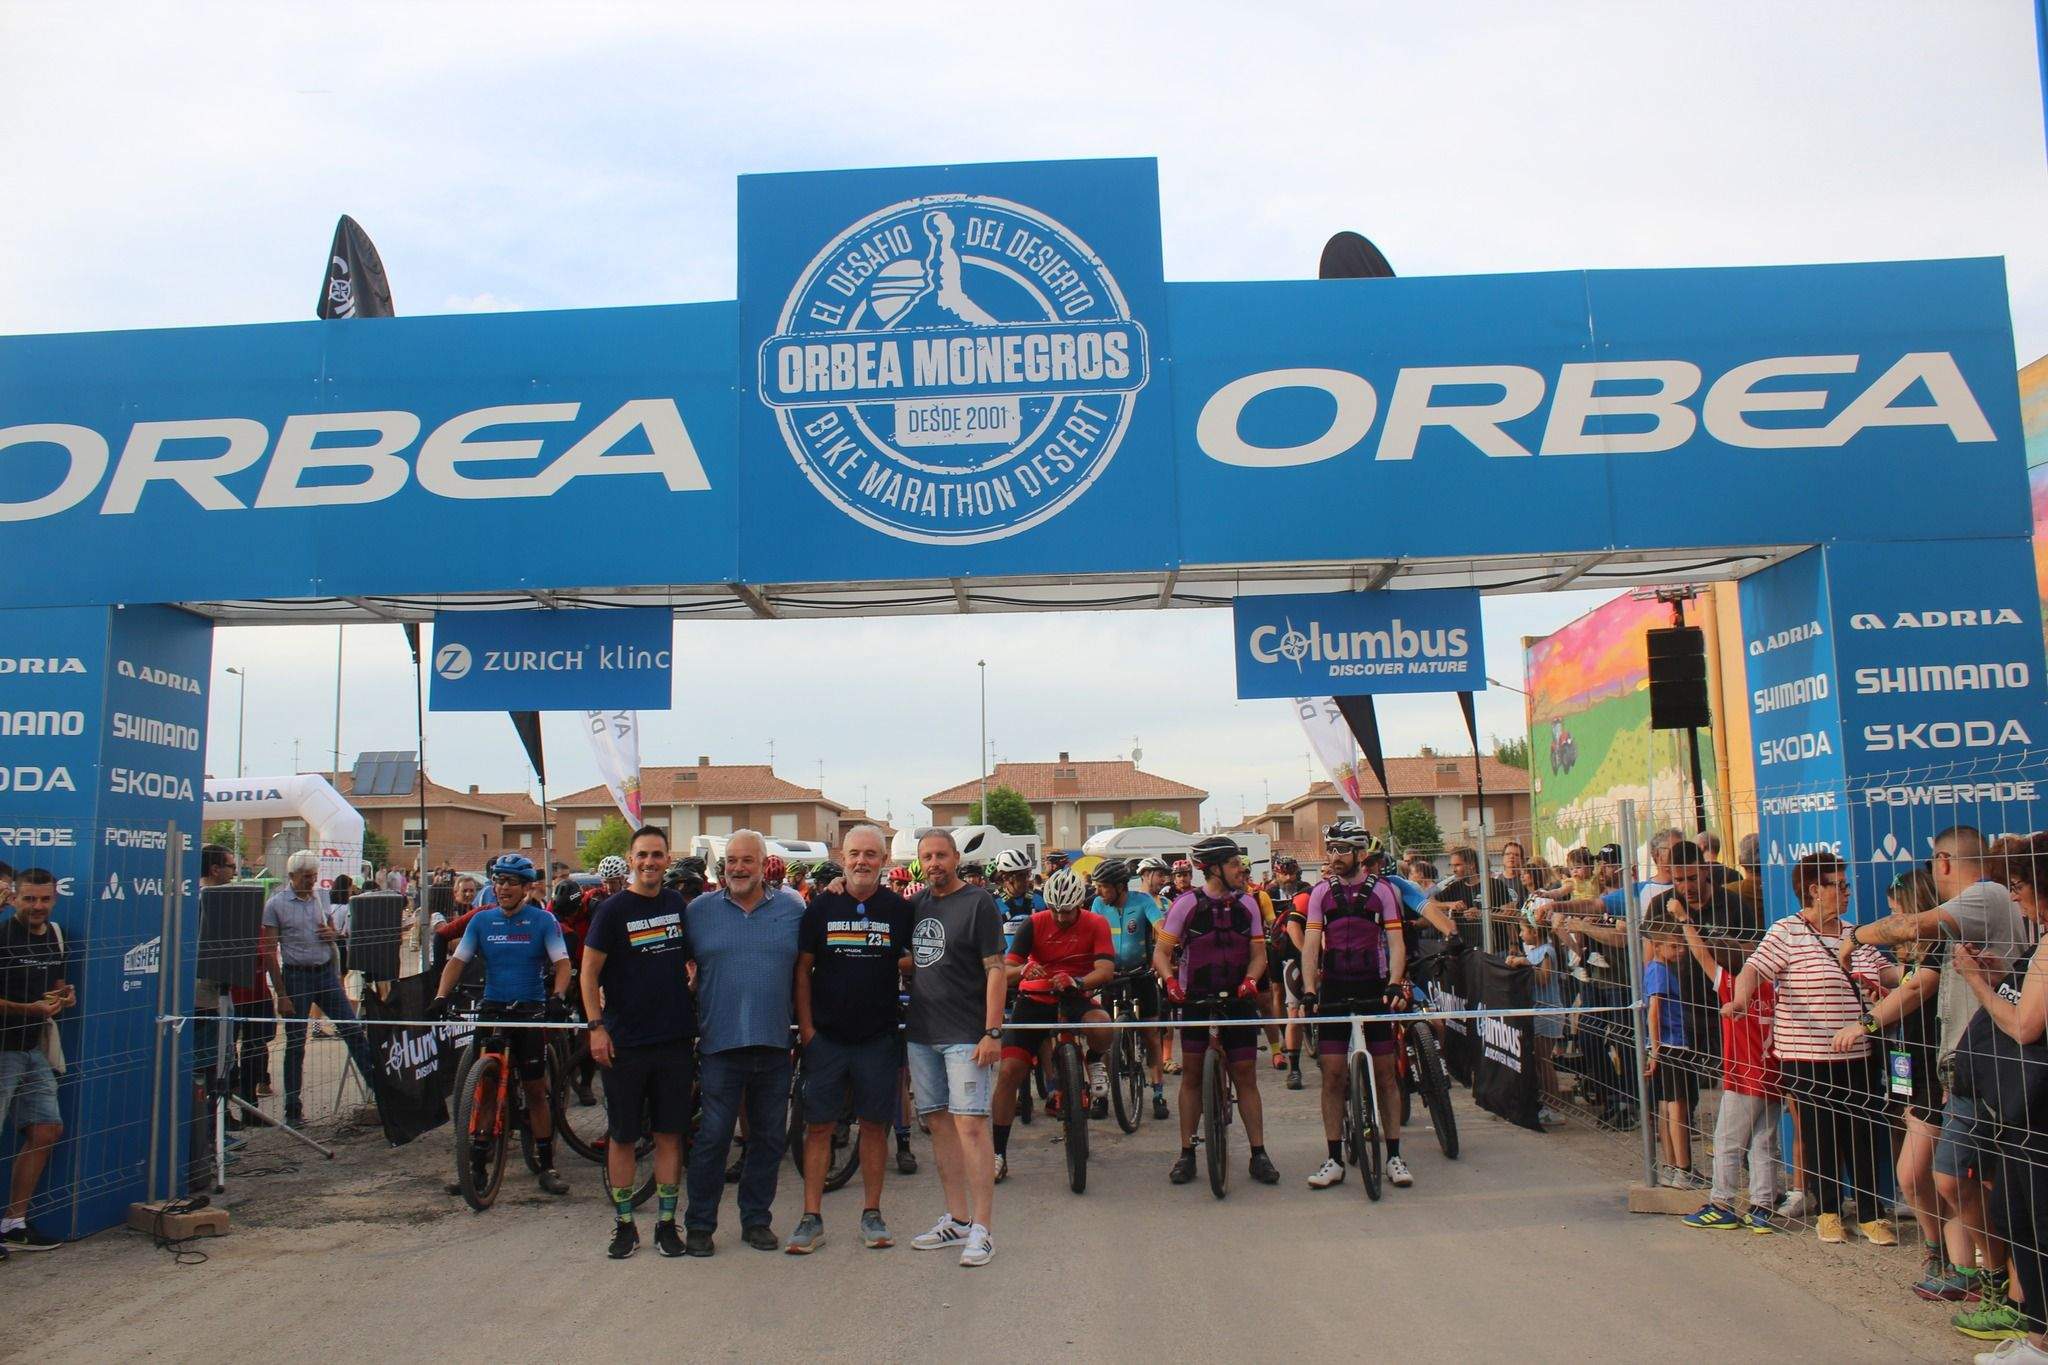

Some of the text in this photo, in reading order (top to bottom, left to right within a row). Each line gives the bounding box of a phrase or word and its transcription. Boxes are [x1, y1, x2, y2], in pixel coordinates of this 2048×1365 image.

[810, 216, 1096, 326] EL DESAFIO DEL DESIERTO
[777, 331, 1130, 395] ORBEA MONEGROS
[908, 406, 1009, 434] DESDE 2001
[1196, 351, 1999, 468] ORBEA
[0, 398, 712, 522] ORBEA
[804, 399, 1109, 519] BIKE MARATHON DESERT
[1892, 608, 2024, 630] ADRIA
[1250, 618, 1469, 665] Columbus
[1766, 620, 1824, 652] ADRIA
[483, 650, 583, 671] ZURICH
[600, 645, 670, 670] klinc
[1329, 660, 1468, 677] DISCOVER NATURE
[139, 667, 202, 695] ADRIA
[1754, 673, 1828, 715] SHIMANO
[1855, 662, 2030, 695] SHIMANO
[112, 711, 199, 751] SHIMANO
[1864, 719, 2032, 751] SKODA
[1760, 730, 1833, 766] SKODA
[110, 767, 194, 802] SKODA
[203, 788, 283, 802] ADRIA
[1865, 782, 2036, 808] POWERADE
[868, 933, 882, 946] 23
